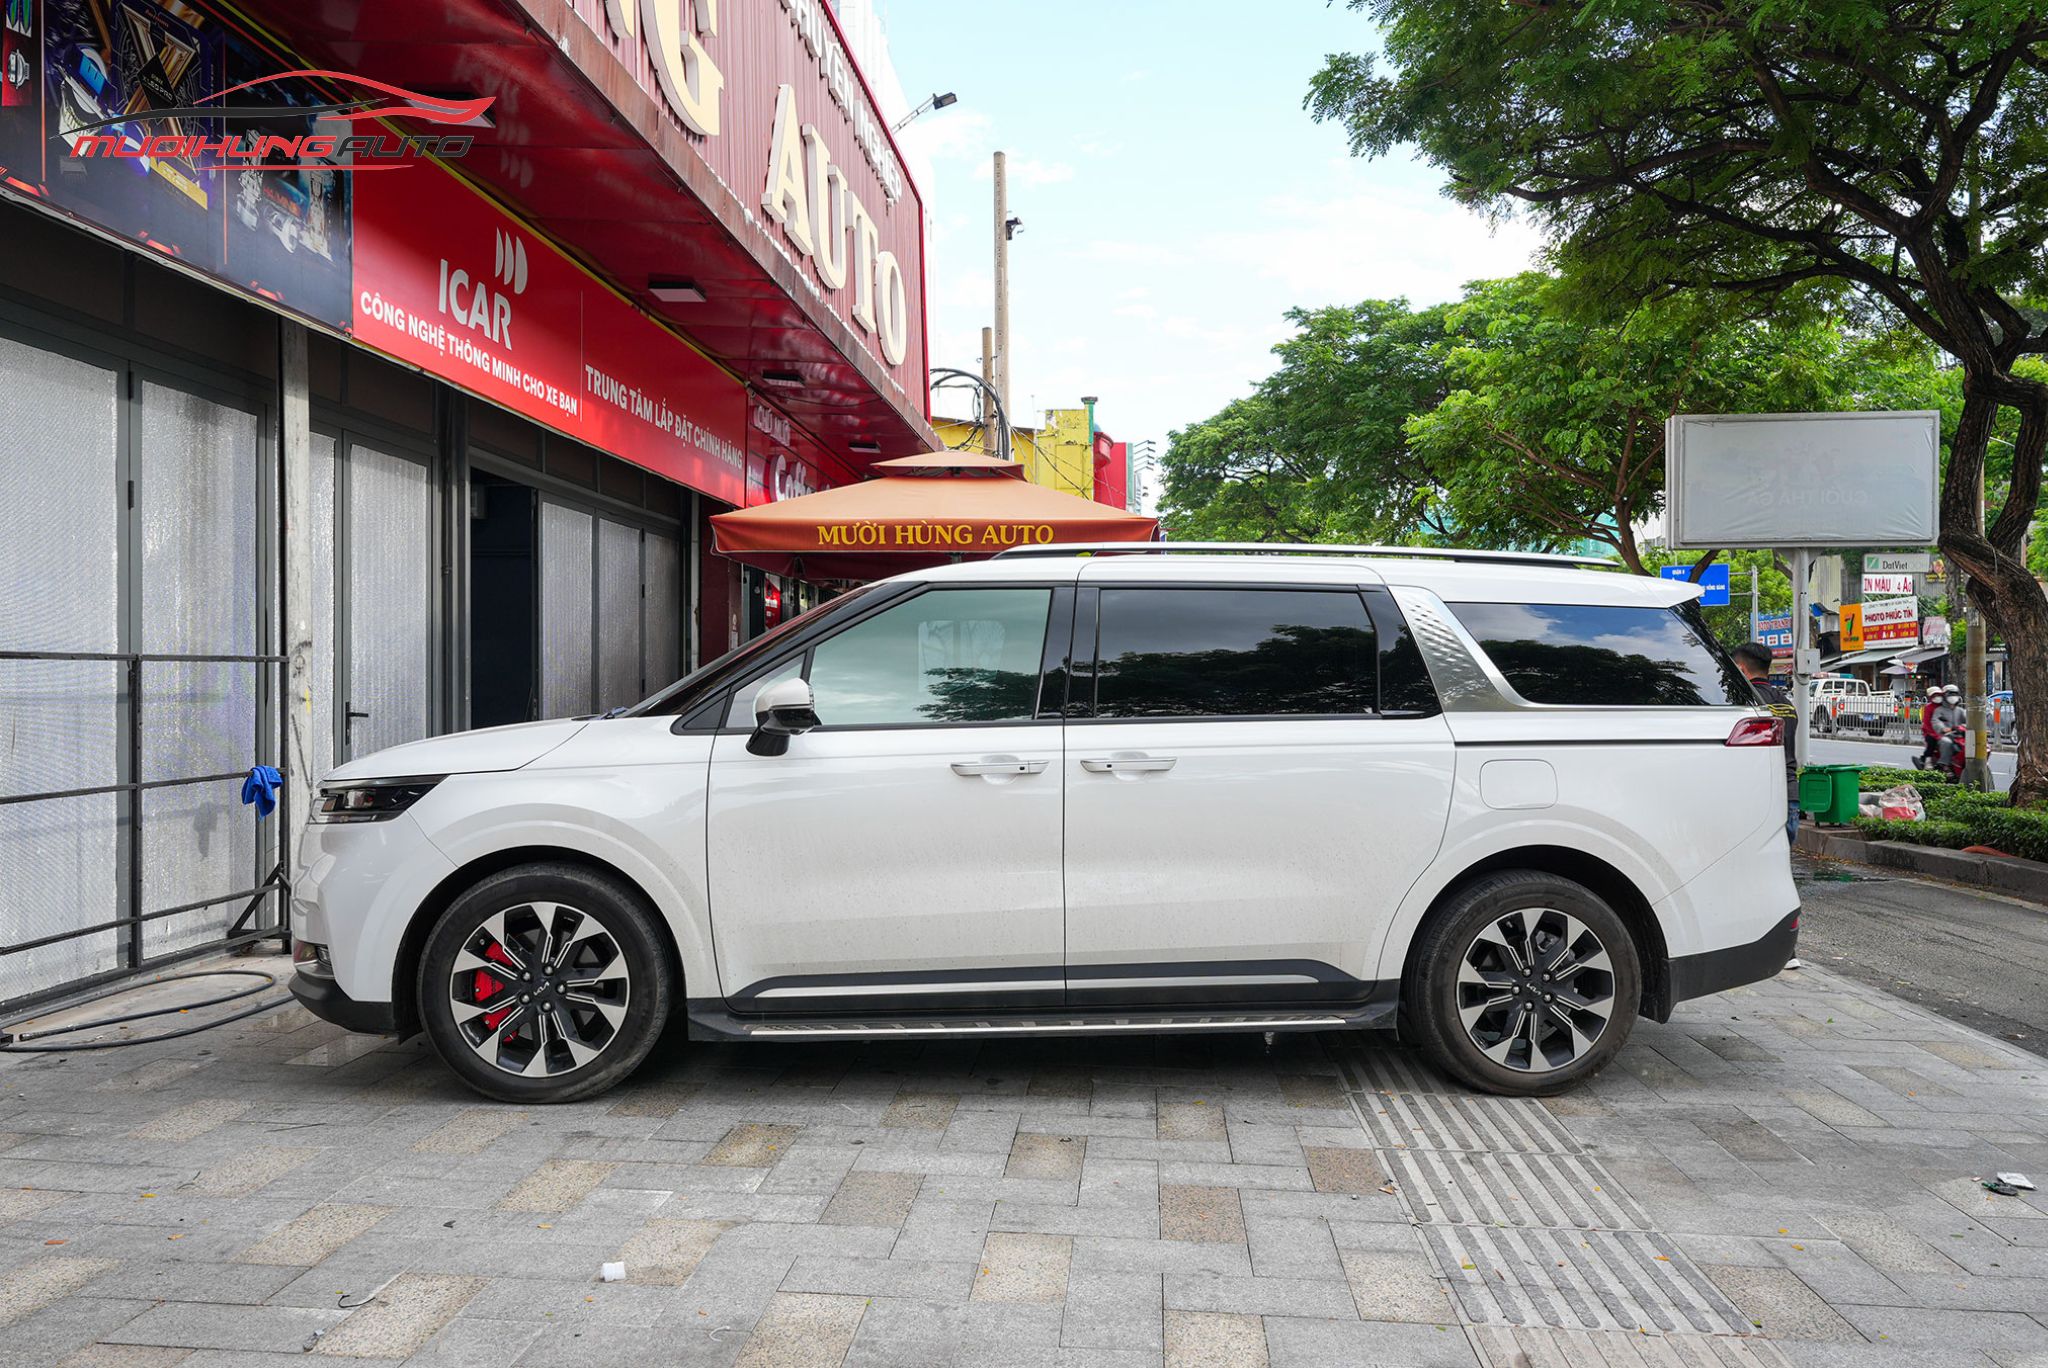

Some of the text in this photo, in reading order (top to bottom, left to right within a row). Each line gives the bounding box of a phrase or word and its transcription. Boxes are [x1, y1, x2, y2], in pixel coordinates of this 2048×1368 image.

[779, 0, 854, 122] HUYÊN
[761, 84, 907, 365] AUTO
[361, 291, 578, 417] CÔNG NGHỆ THÔNG MINH CHO XE BẠN
[438, 258, 512, 351] ICAR
[585, 364, 743, 469] TRUNG TÂM LẮP ĐẶT CHÍNH HÀNG
[817, 520, 1054, 545] MƯỜI HÙNG AUTO
[1864, 578, 1873, 592] IN
[1874, 576, 1891, 592] MÀU
[1864, 606, 1913, 622] PHOTO PHÚC TÍN
